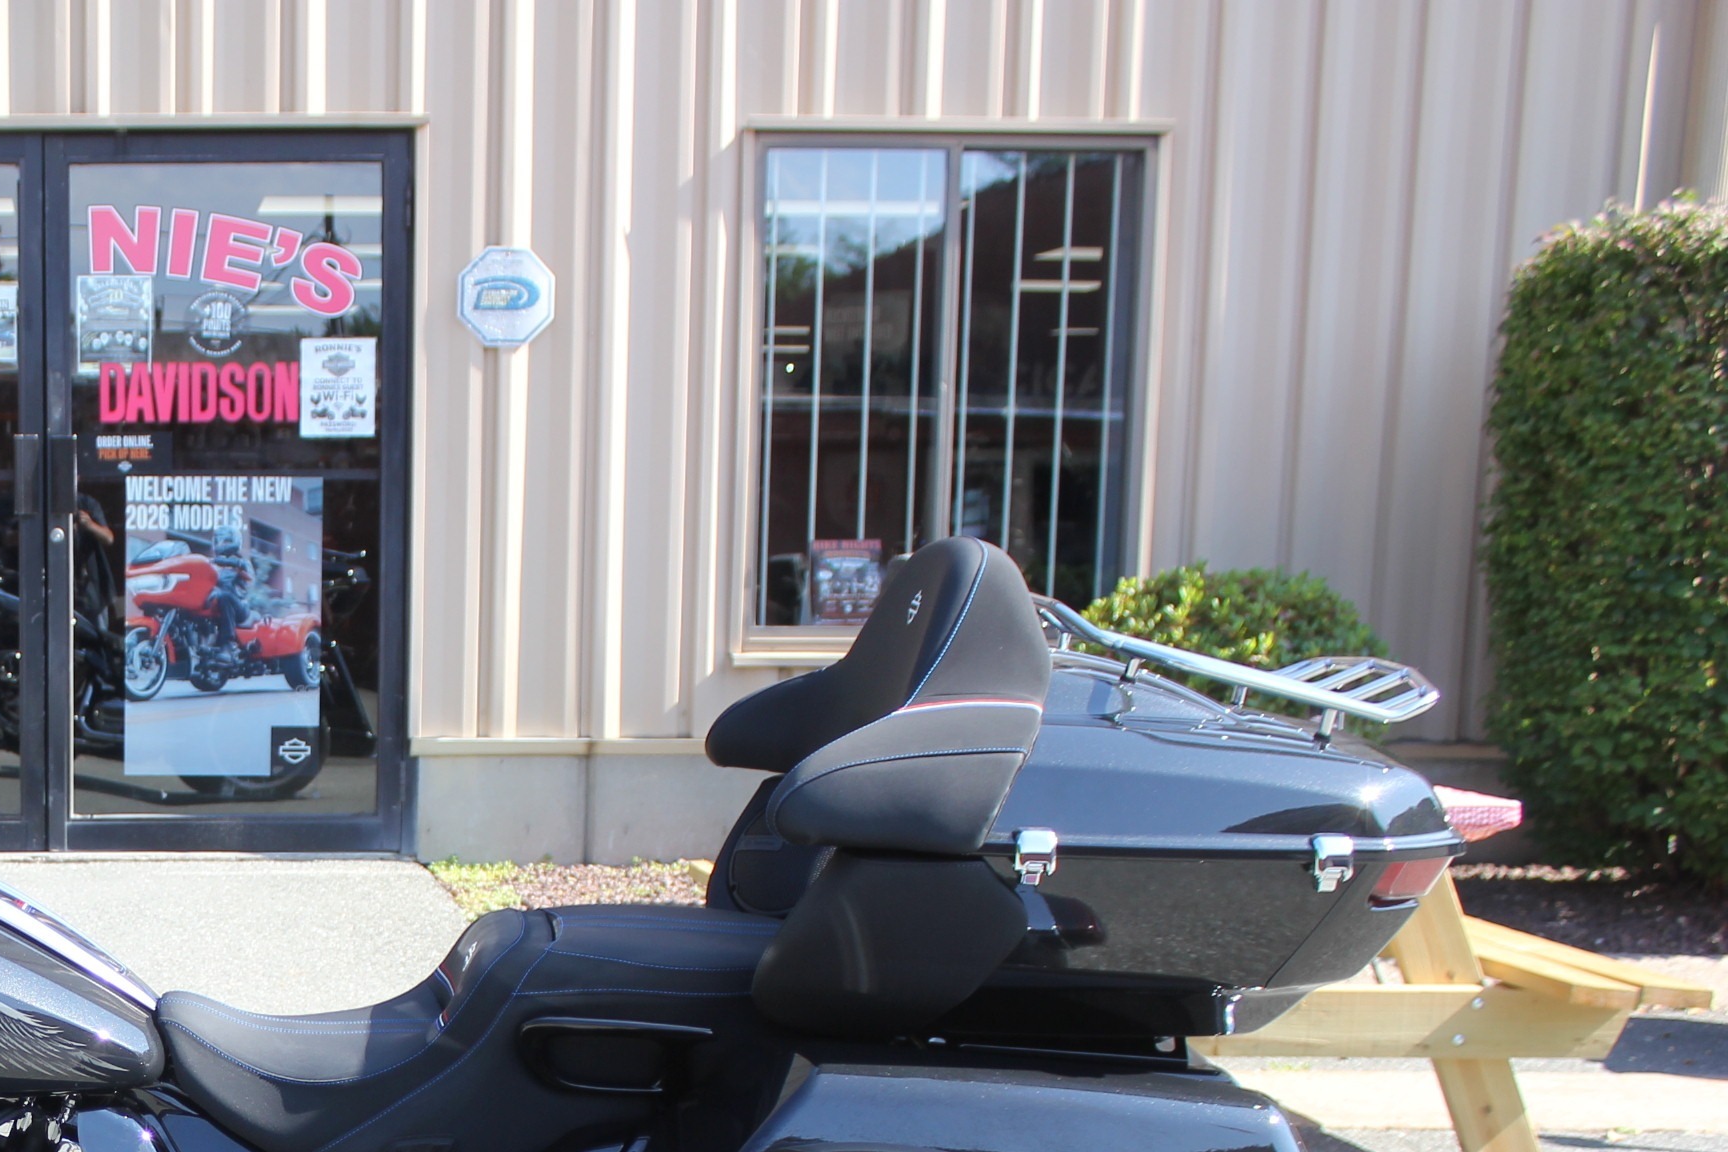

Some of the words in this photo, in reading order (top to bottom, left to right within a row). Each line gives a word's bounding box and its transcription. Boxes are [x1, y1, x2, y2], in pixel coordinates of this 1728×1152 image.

[87, 205, 363, 318] NIE'S
[314, 344, 362, 353] RONNIE'S
[99, 361, 299, 423] DAVIDSON
[96, 435, 122, 448] ORDER
[122, 435, 154, 448] ONLINE.
[98, 448, 117, 460] PICK
[118, 448, 129, 460] UP
[125, 475, 212, 503] WELCOME
[214, 476, 248, 502] THE
[250, 476, 293, 503] NEW
[125, 504, 170, 531] 2026
[174, 504, 248, 531] MODELS.
